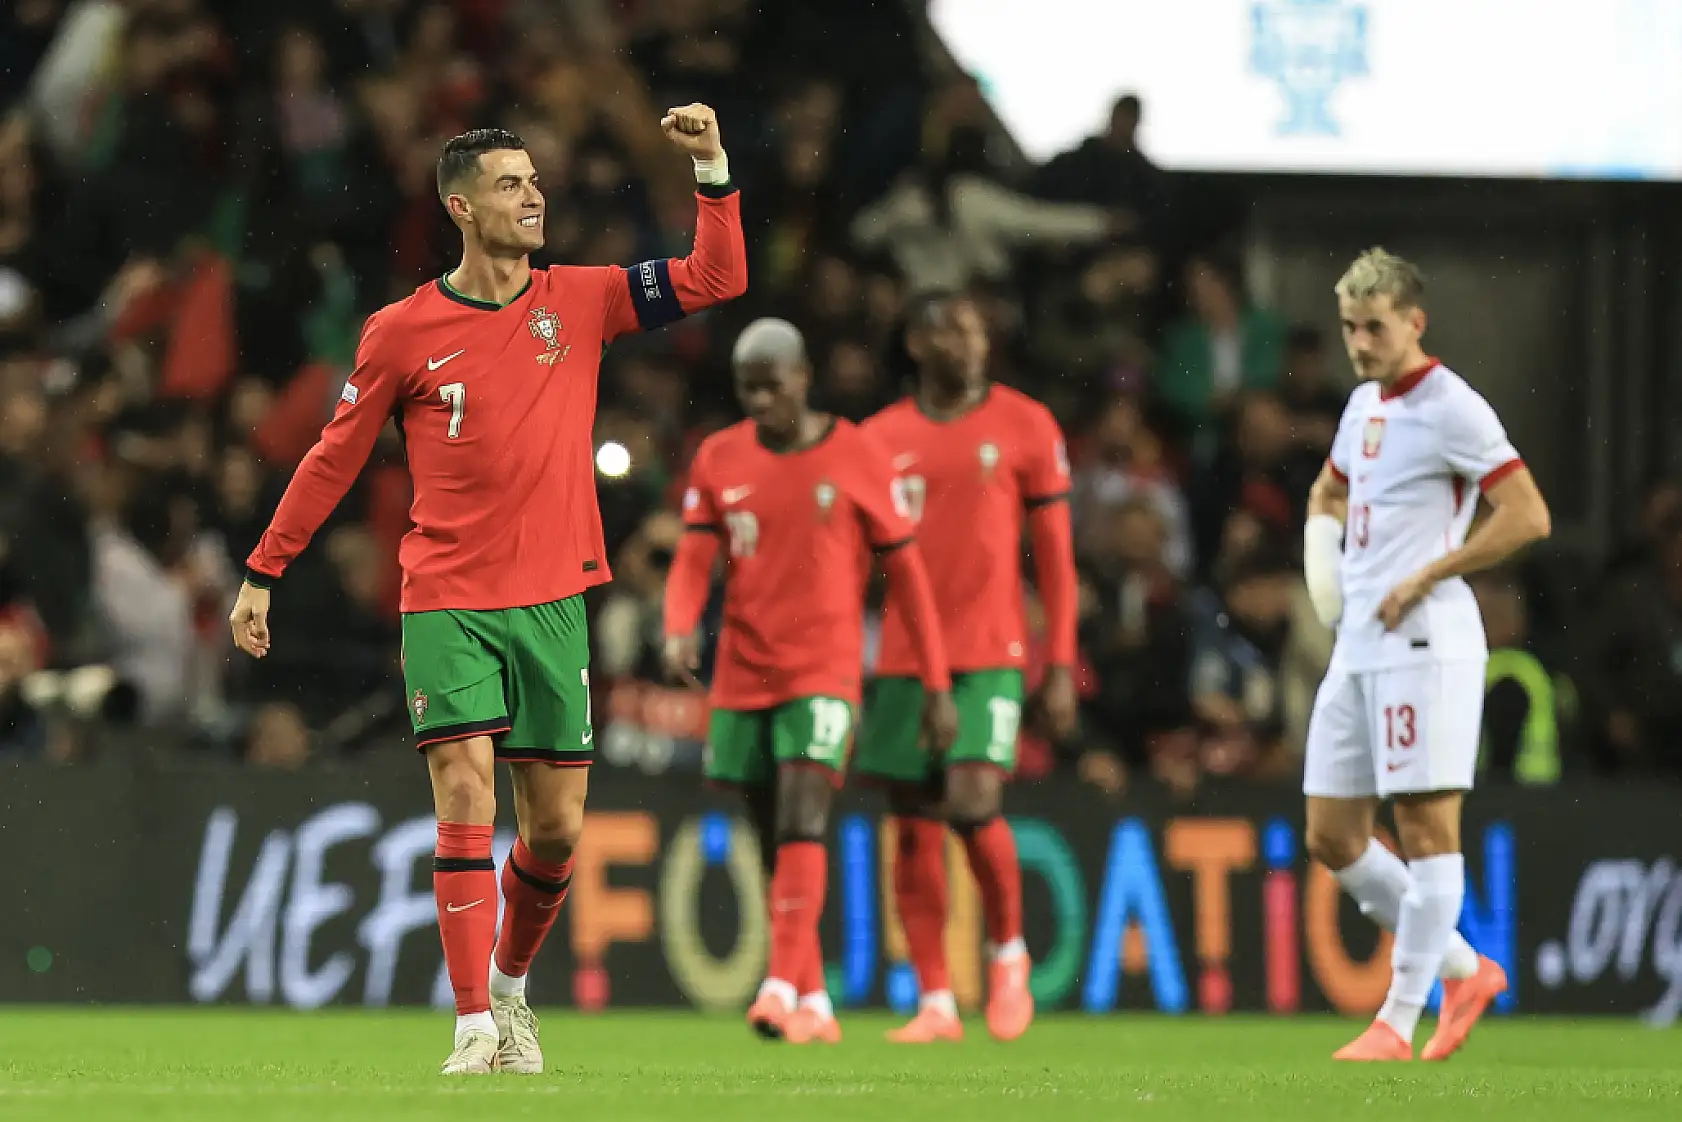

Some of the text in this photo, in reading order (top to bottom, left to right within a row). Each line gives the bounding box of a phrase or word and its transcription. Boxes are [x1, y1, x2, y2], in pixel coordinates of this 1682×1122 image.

[439, 382, 465, 438] 7
[1384, 703, 1416, 750] 13
[187, 802, 512, 1010] UEF
